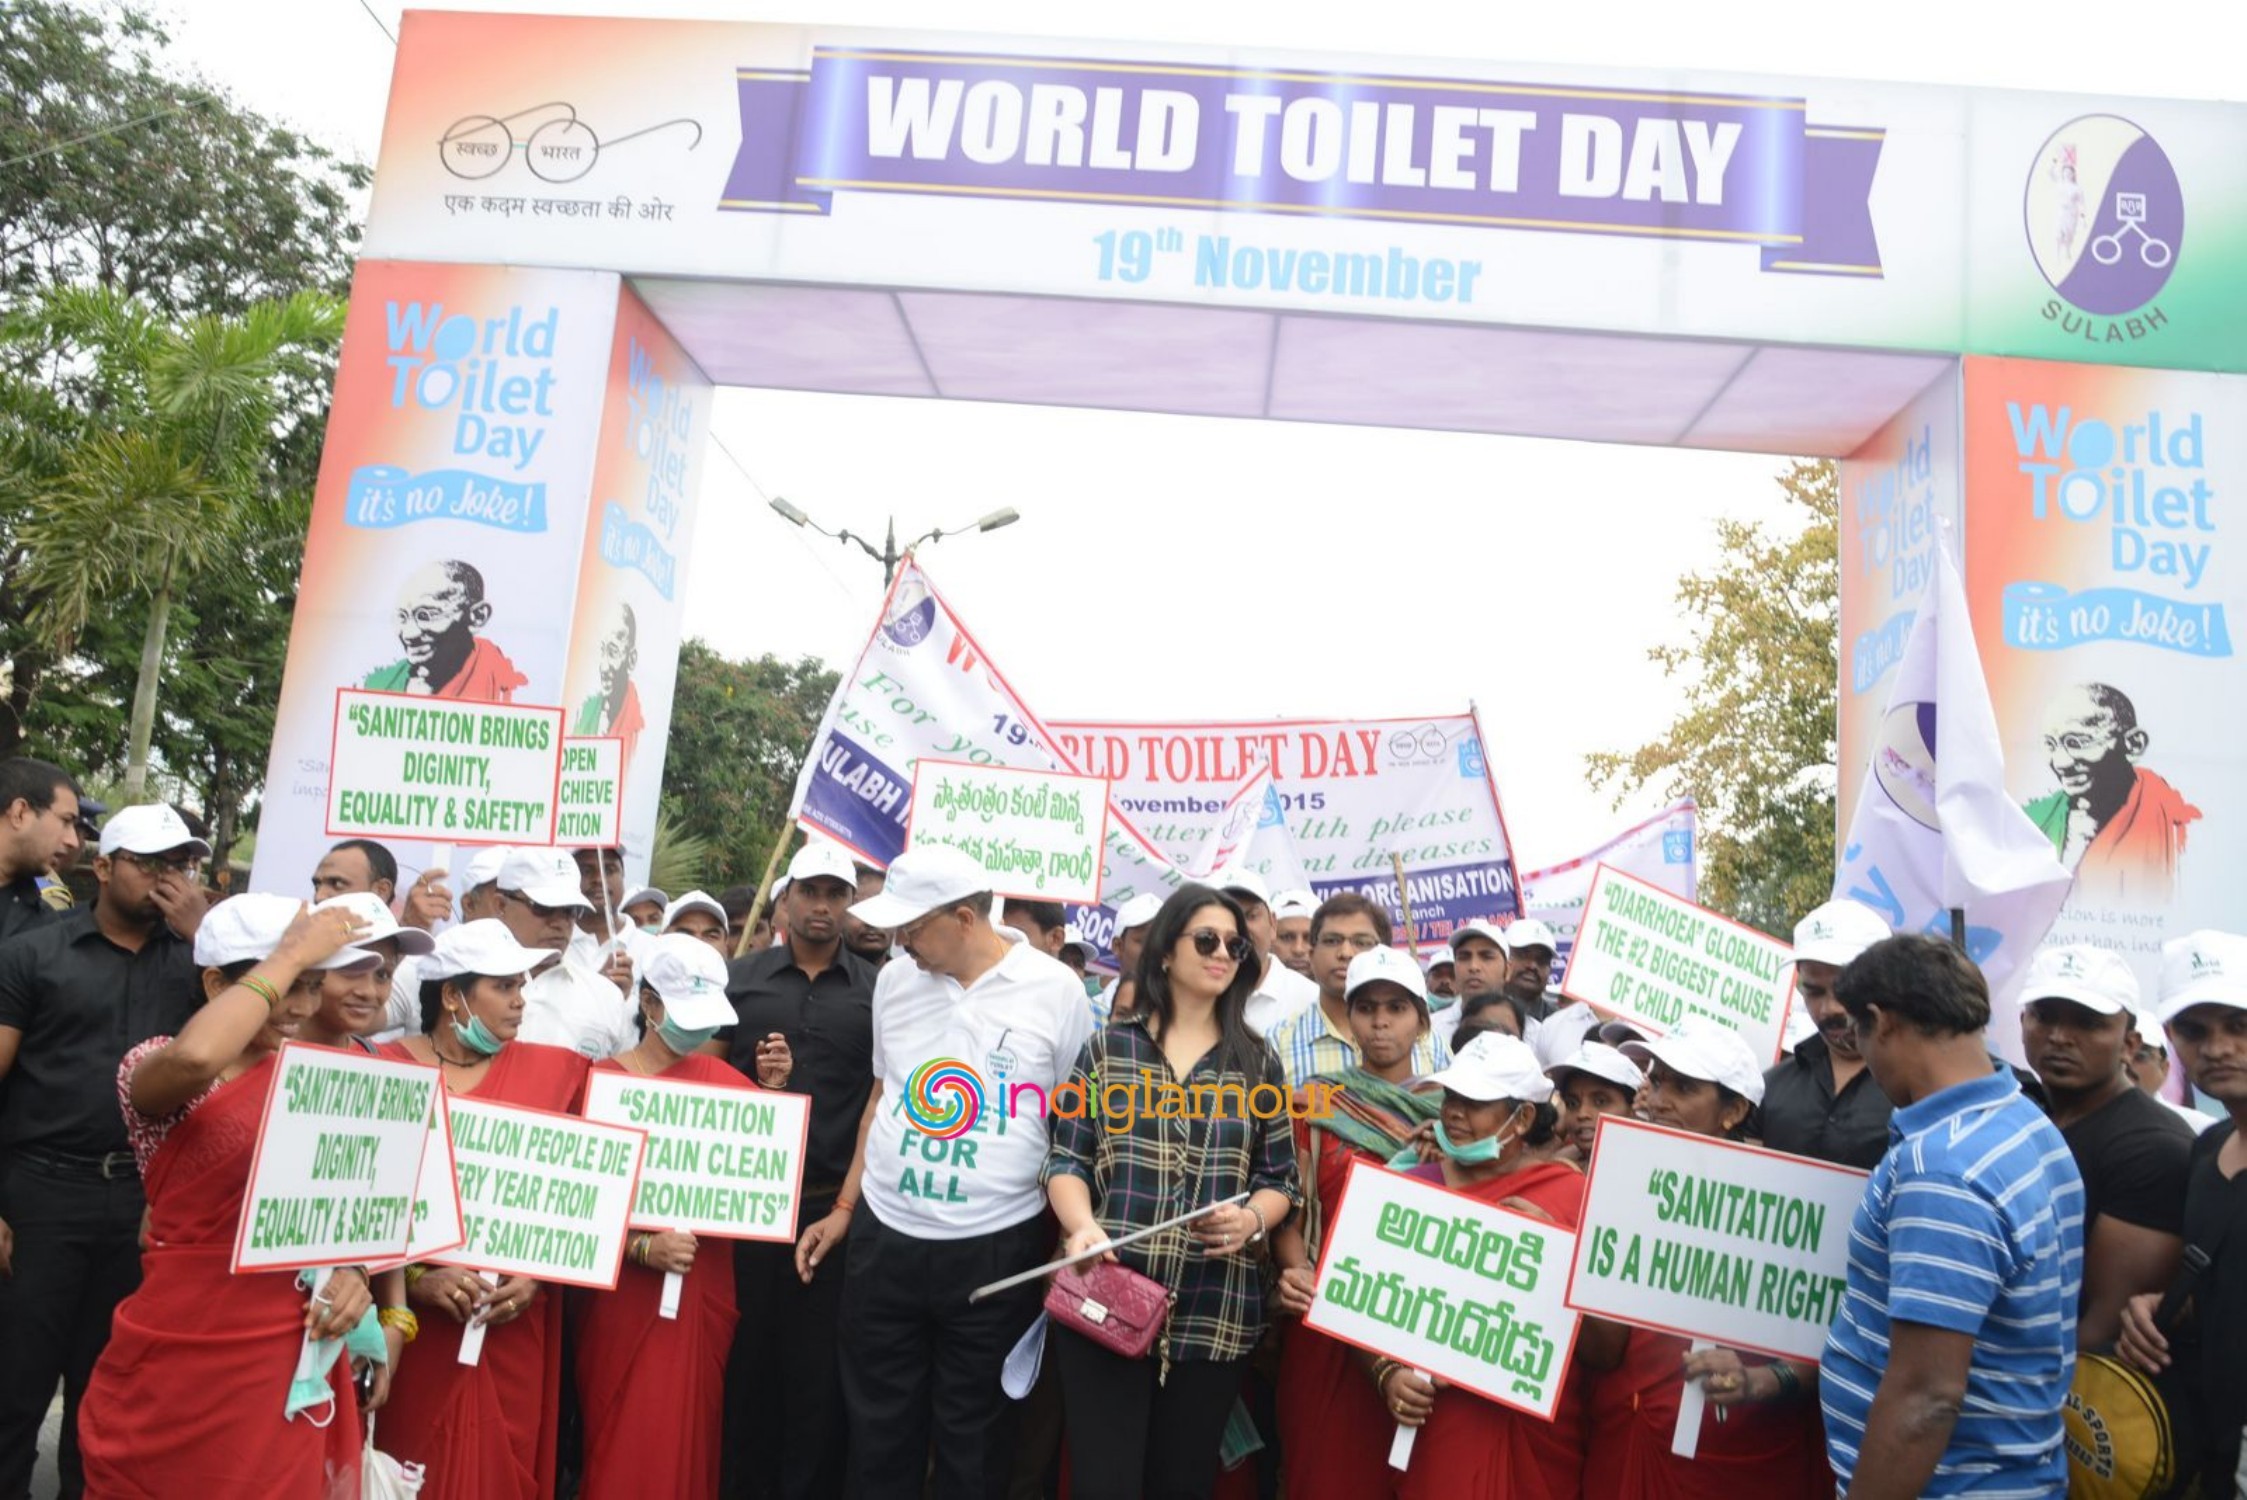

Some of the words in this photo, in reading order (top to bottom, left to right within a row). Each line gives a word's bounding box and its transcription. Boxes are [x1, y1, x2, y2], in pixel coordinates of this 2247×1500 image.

[456, 141, 498, 157] स्वच्छ
[540, 145, 582, 161] भारत
[868, 75, 1200, 172] WORLD
[1225, 94, 1537, 193] TOILET
[1559, 112, 1743, 206] DAY
[444, 193, 475, 216] एक
[480, 194, 525, 218] कदम
[531, 197, 602, 218] स्वच्छता
[607, 194, 632, 220] की
[638, 196, 674, 222] ओर
[1093, 226, 1185, 283] 19th
[1194, 234, 1482, 303] November
[2041, 299, 2169, 342] SULABH
[453, 413, 546, 471] Day
[405, 485, 443, 516] no
[2111, 527, 2211, 590] Day
[2069, 604, 2110, 640] no
[348, 703, 475, 743] “SANITATION
[480, 715, 550, 750] BRINGS
[860, 670, 937, 726] For
[932, 734, 1006, 766] yo
[403, 752, 490, 795] DIGINITY,
[822, 739, 902, 814] ULABH
[1299, 729, 1382, 780] DAY
[339, 790, 439, 826] EQUALITY
[444, 800, 458, 828] &
[464, 798, 545, 833] SAFETY”
[561, 780, 613, 805] CHIEVE
[1120, 796, 1228, 814] ovember
[1281, 791, 1326, 811] 015
[557, 812, 602, 837] ATION
[1368, 806, 1473, 842] please
[1353, 838, 1492, 870] diseases
[1395, 904, 1446, 922] Banch
[1595, 919, 1628, 959] THE
[1628, 936, 1650, 969] #2
[1650, 945, 1720, 999] BIGGEST
[1720, 976, 1774, 1024] CAUSE
[1705, 926, 1785, 984] GLOBALLY
[1610, 971, 1634, 1004] OF
[1634, 981, 1684, 1026] CHILD
[285, 1064, 381, 1119] “SANITATION
[377, 1075, 430, 1124] BRINGS
[619, 1088, 776, 1137] “SANITATION
[311, 1132, 381, 1191] DIGINITY,
[525, 1125, 598, 1171] PEOPLE
[598, 1139, 632, 1177] DIE
[645, 1135, 702, 1173] TAIN
[707, 1142, 788, 1182] CLEAN
[899, 1128, 979, 1169] FOR
[492, 1168, 543, 1211] YEAR
[543, 1178, 600, 1220] FROM
[632, 1179, 790, 1226] IRONMENTS”
[898, 1166, 968, 1203] ALL
[251, 1196, 336, 1250] EQUALITY
[333, 1196, 348, 1245] &
[1648, 1168, 1826, 1254] “SANITATION
[485, 1218, 600, 1270] SANITATION
[1587, 1225, 1619, 1278] IS
[1619, 1233, 1641, 1284] A
[1647, 1238, 1754, 1308] HUMAN
[1756, 1261, 1848, 1326] RIGHT
